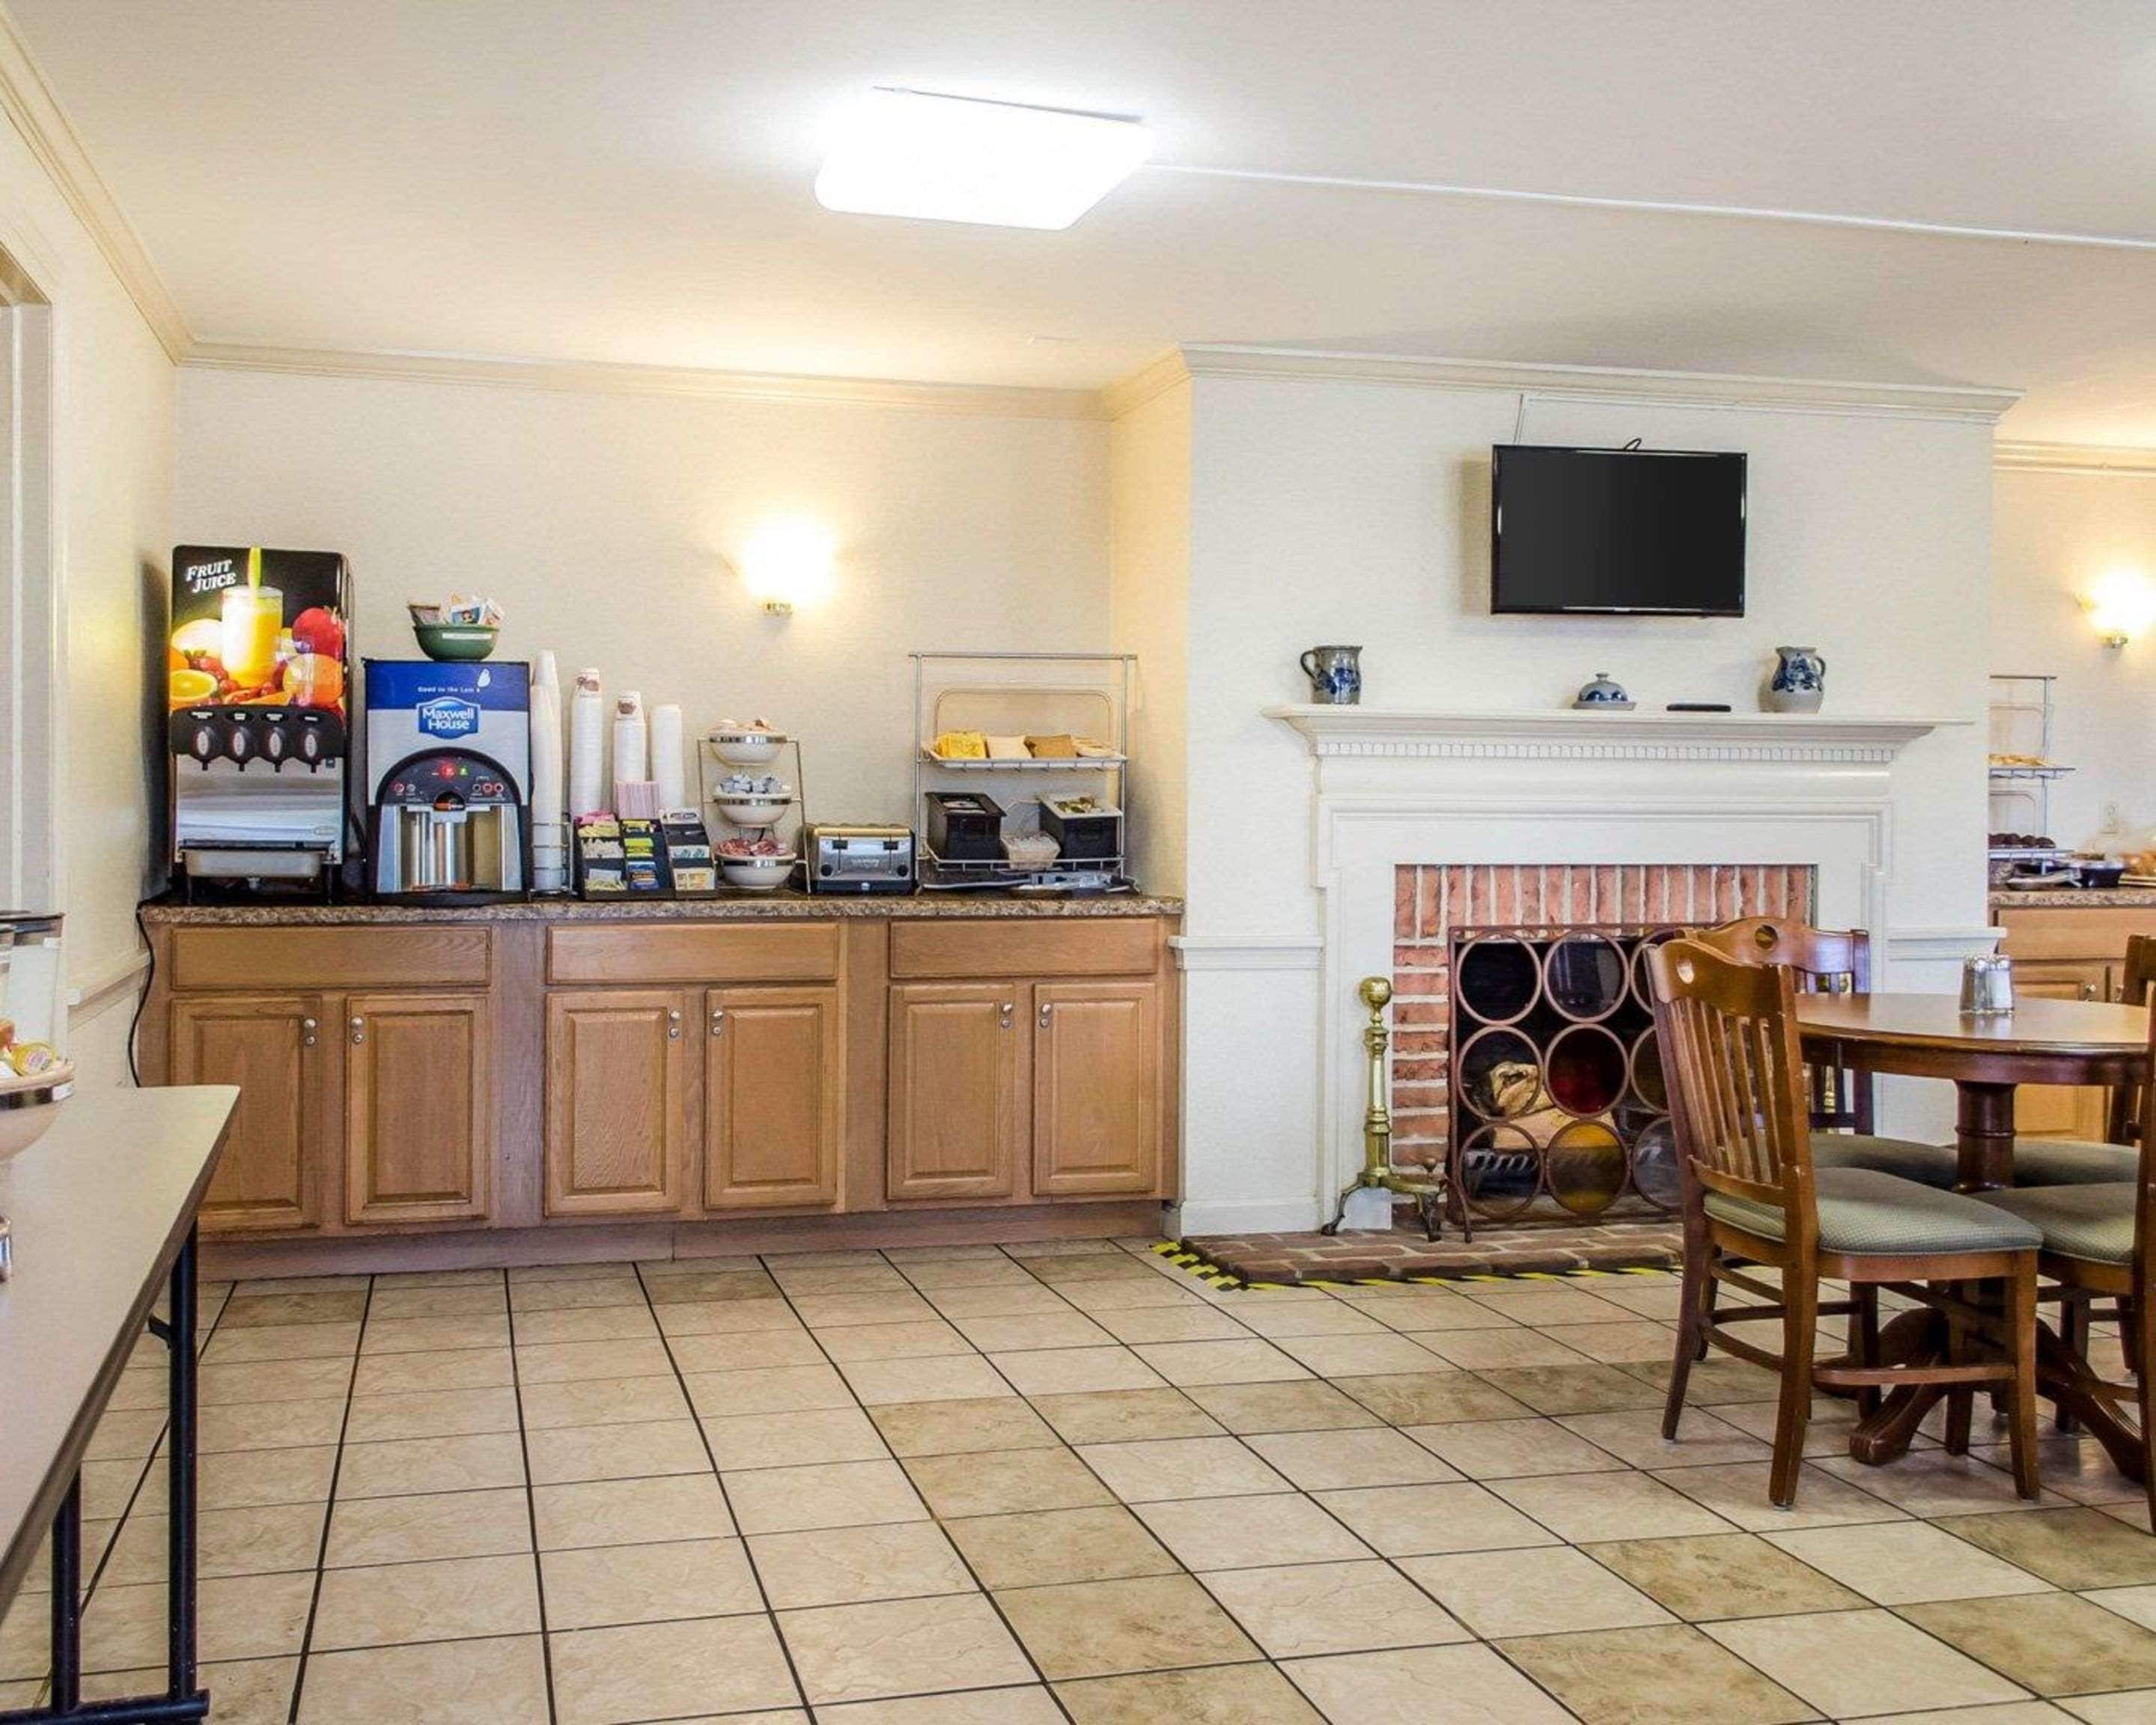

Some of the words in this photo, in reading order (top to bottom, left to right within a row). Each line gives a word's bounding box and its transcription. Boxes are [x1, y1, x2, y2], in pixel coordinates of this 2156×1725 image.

[186, 559, 233, 582] FRUIT
[192, 572, 237, 593] JUICE
[422, 706, 475, 719] Maxwell
[427, 719, 470, 731] House
